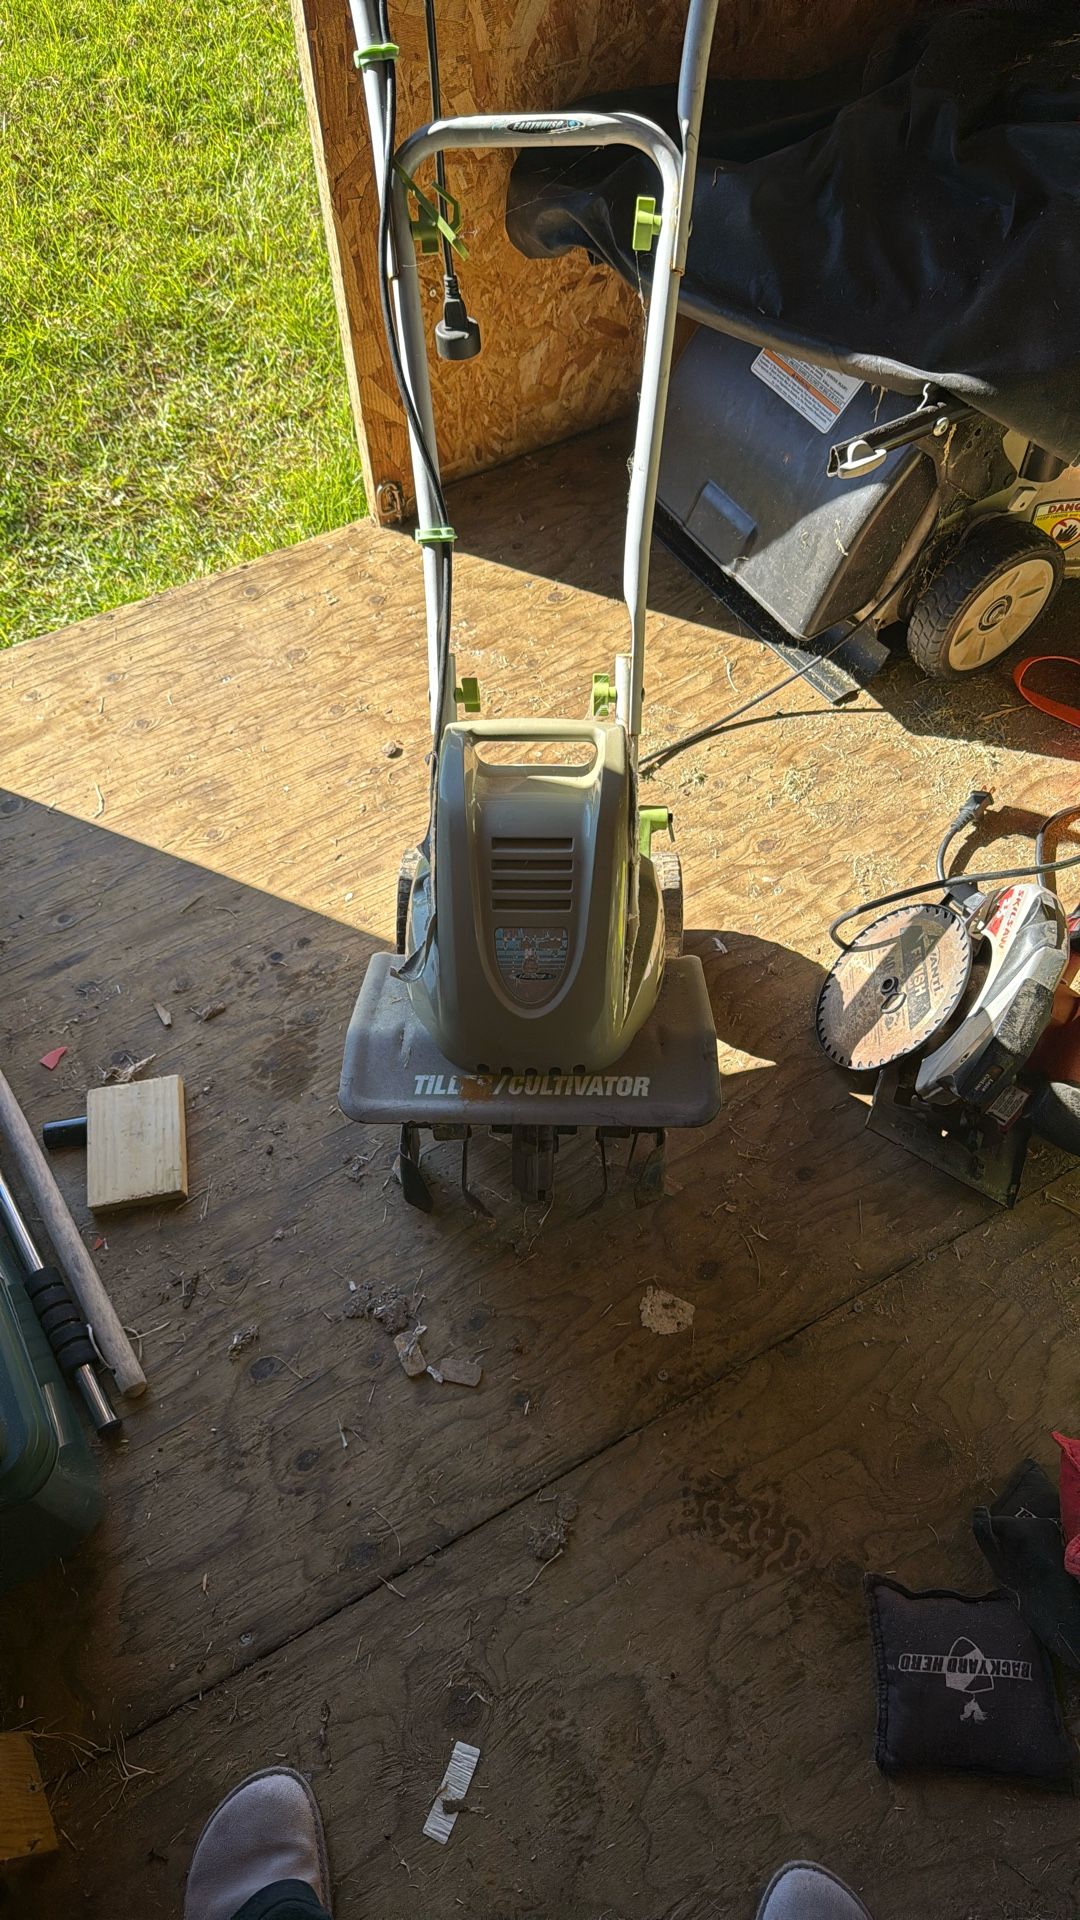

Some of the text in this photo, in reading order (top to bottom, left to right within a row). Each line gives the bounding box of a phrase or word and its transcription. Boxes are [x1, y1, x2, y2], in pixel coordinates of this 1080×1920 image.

[910, 945, 927, 997] FINISH
[414, 1074, 650, 1097] TILL/CULTIVATOR
[900, 1655, 944, 1673] HERO
[946, 1657, 1031, 1679] BACKYARD
